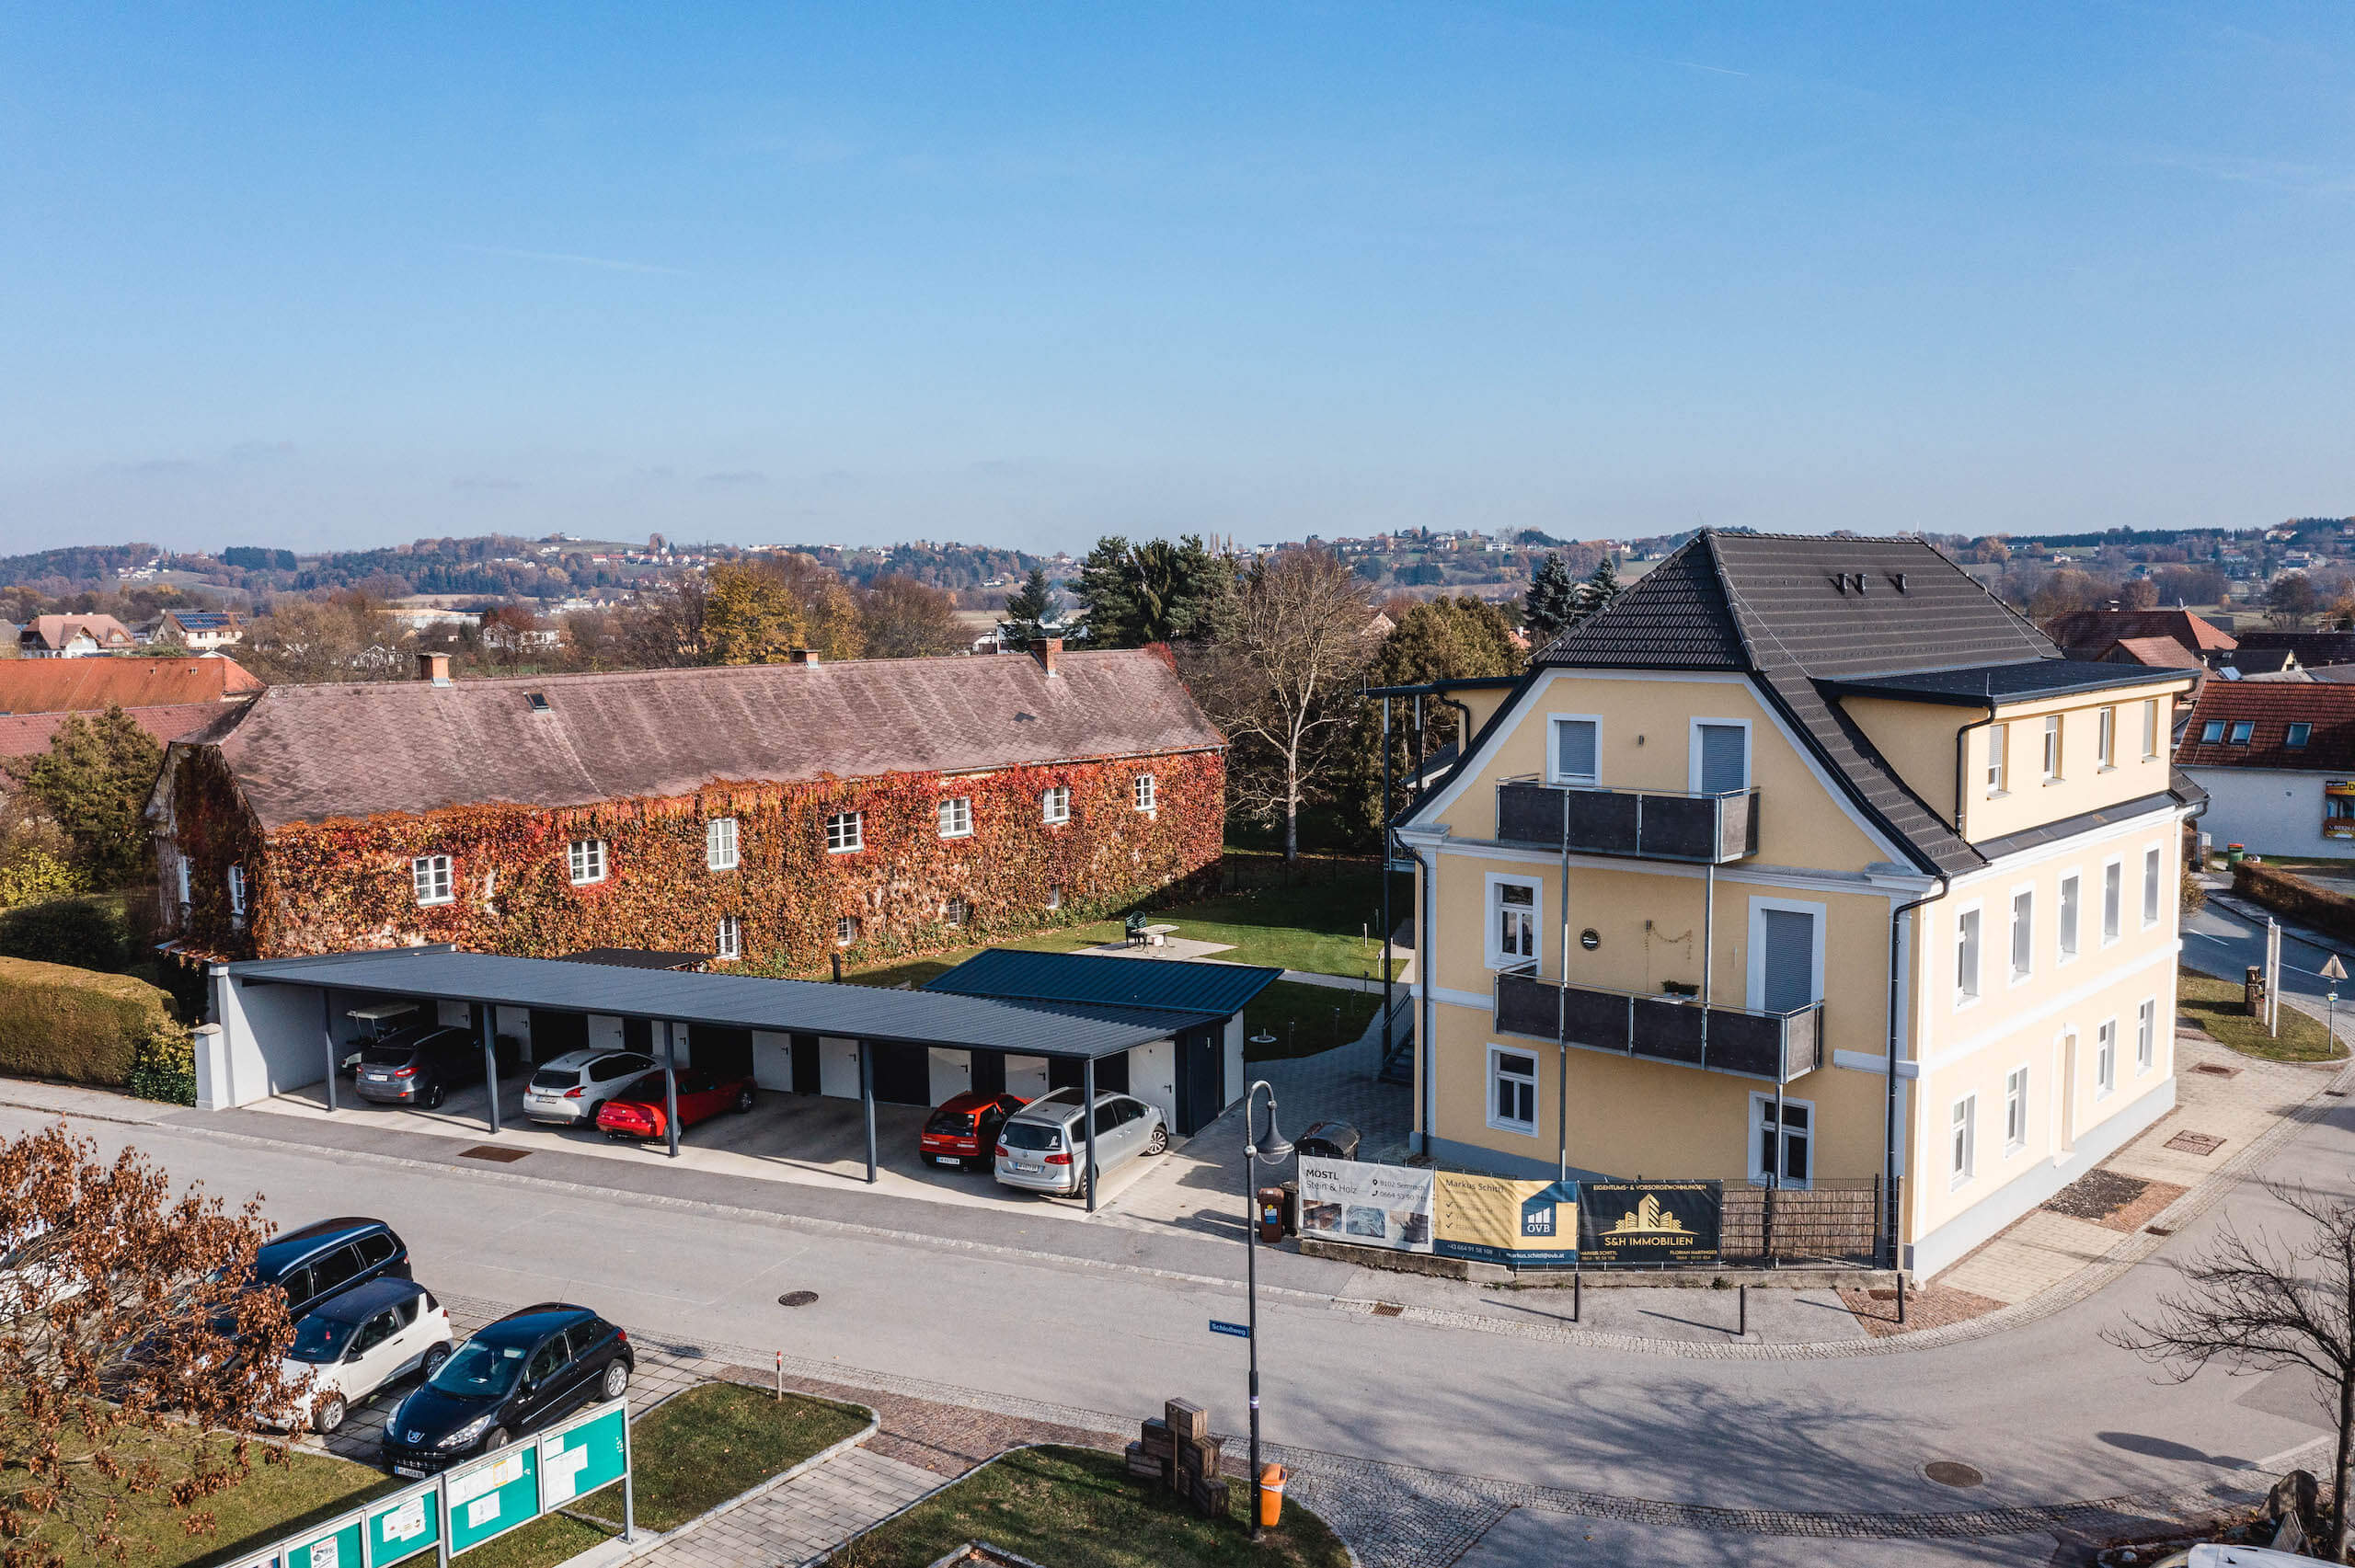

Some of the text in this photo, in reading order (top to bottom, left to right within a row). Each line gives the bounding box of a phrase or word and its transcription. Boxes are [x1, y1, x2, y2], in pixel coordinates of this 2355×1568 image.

[1306, 1168, 1339, 1181] MÖSTL
[1306, 1181, 1358, 1194] Stein & Holz
[1445, 1179, 1476, 1190] Markus
[1527, 1224, 1551, 1233] OVB
[1604, 1236, 1694, 1246] S&H IMMOBILIEN
